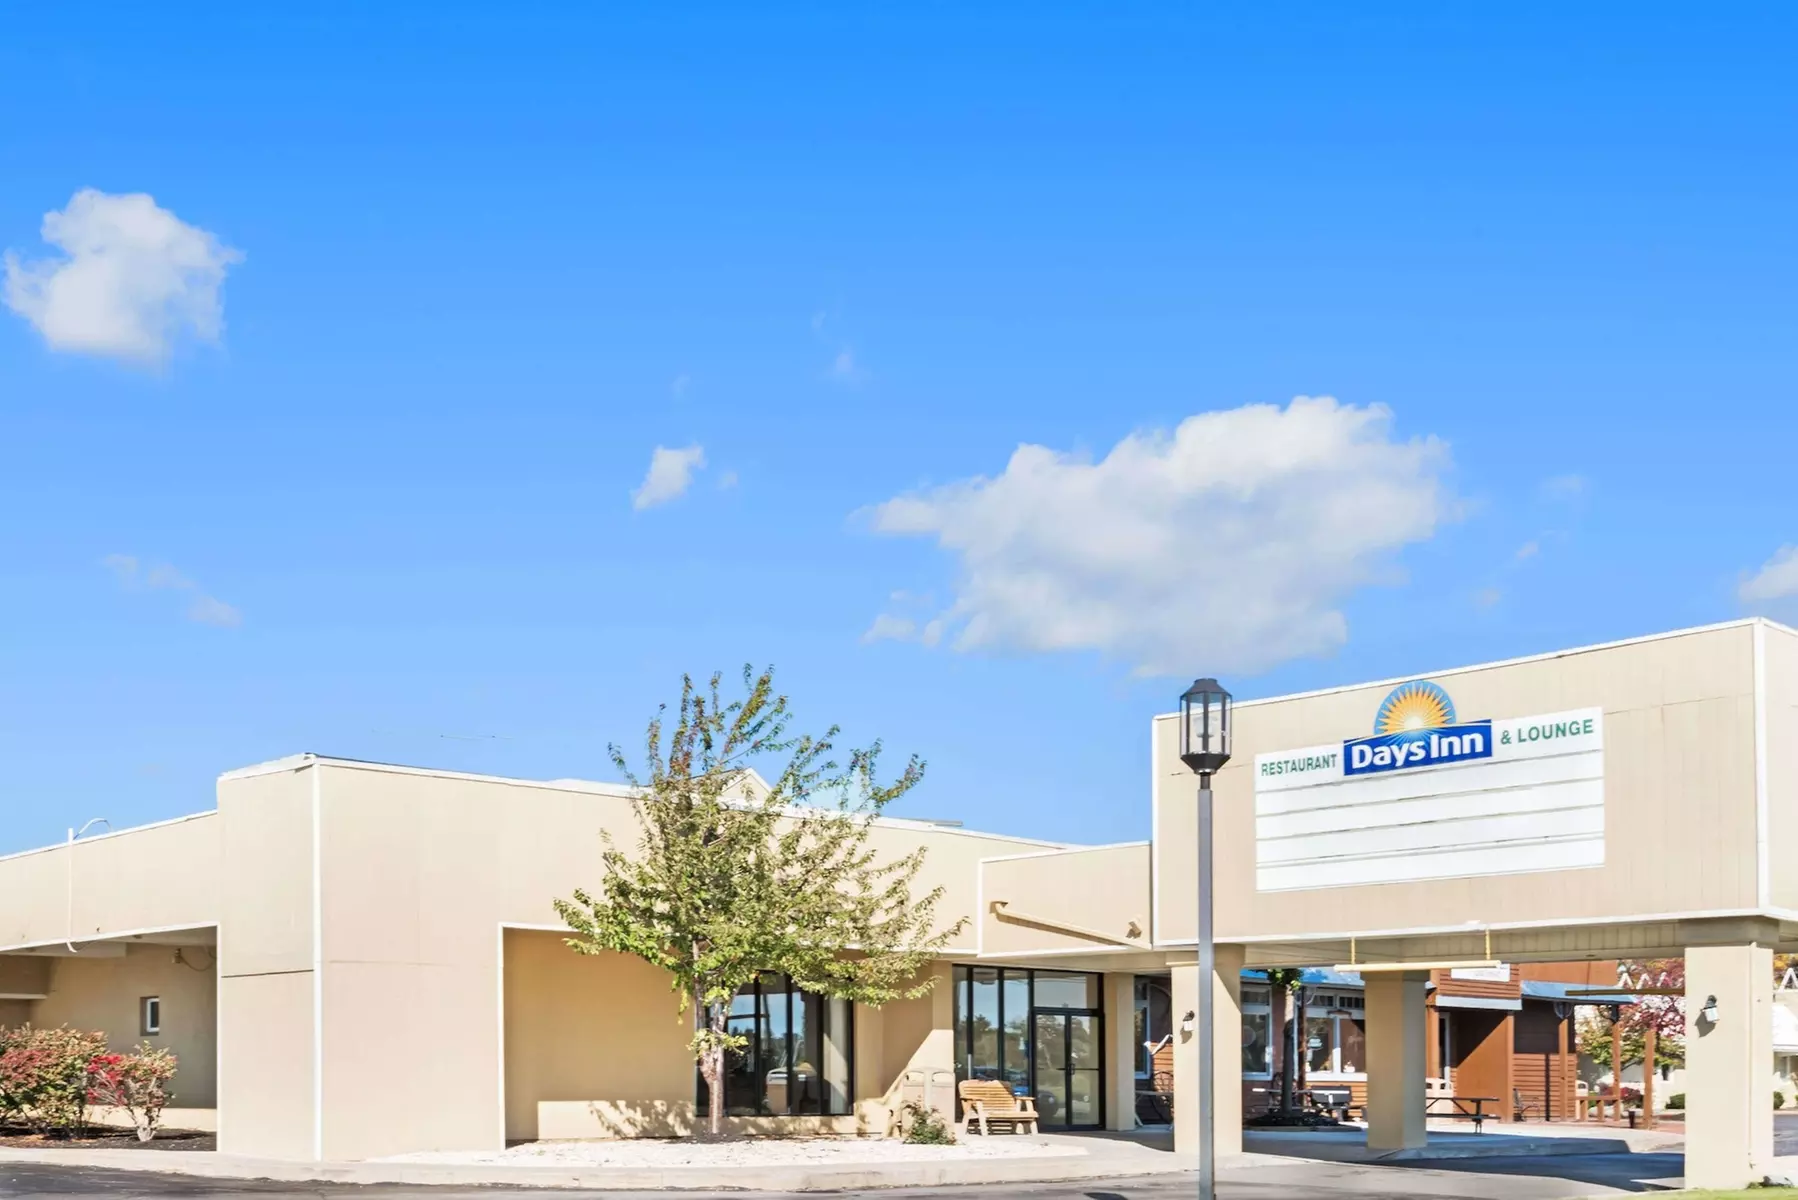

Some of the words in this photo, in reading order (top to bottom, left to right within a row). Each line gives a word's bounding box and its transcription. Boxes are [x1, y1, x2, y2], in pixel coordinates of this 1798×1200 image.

[1500, 730, 1512, 745] &
[1518, 719, 1594, 743] LOUNGE
[1351, 739, 1425, 769] Days
[1430, 732, 1484, 758] Inn
[1260, 753, 1337, 777] RESTAURANT
